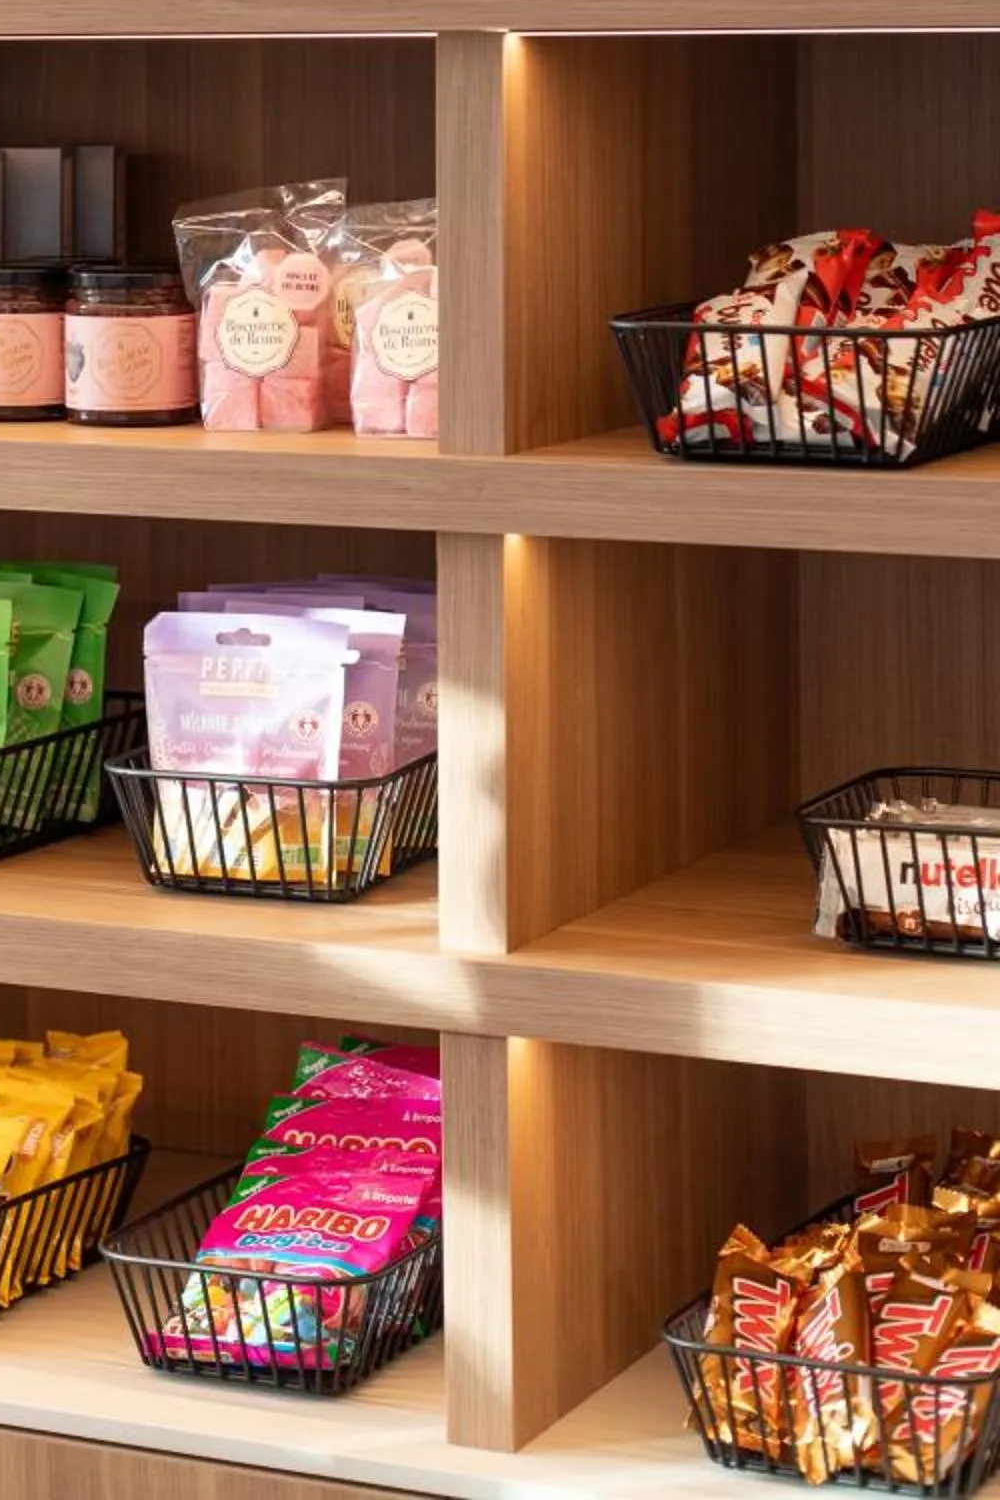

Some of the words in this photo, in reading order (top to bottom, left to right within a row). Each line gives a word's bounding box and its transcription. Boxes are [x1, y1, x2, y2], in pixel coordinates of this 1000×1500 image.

[226, 319, 287, 333] Biscuiterie
[229, 331, 243, 345] de
[247, 331, 283, 345] Reims
[383, 337, 396, 350] de
[900, 857, 1000, 891] nutell
[234, 1204, 391, 1243] HARIBO
[235, 1230, 352, 1253] Dragibus
